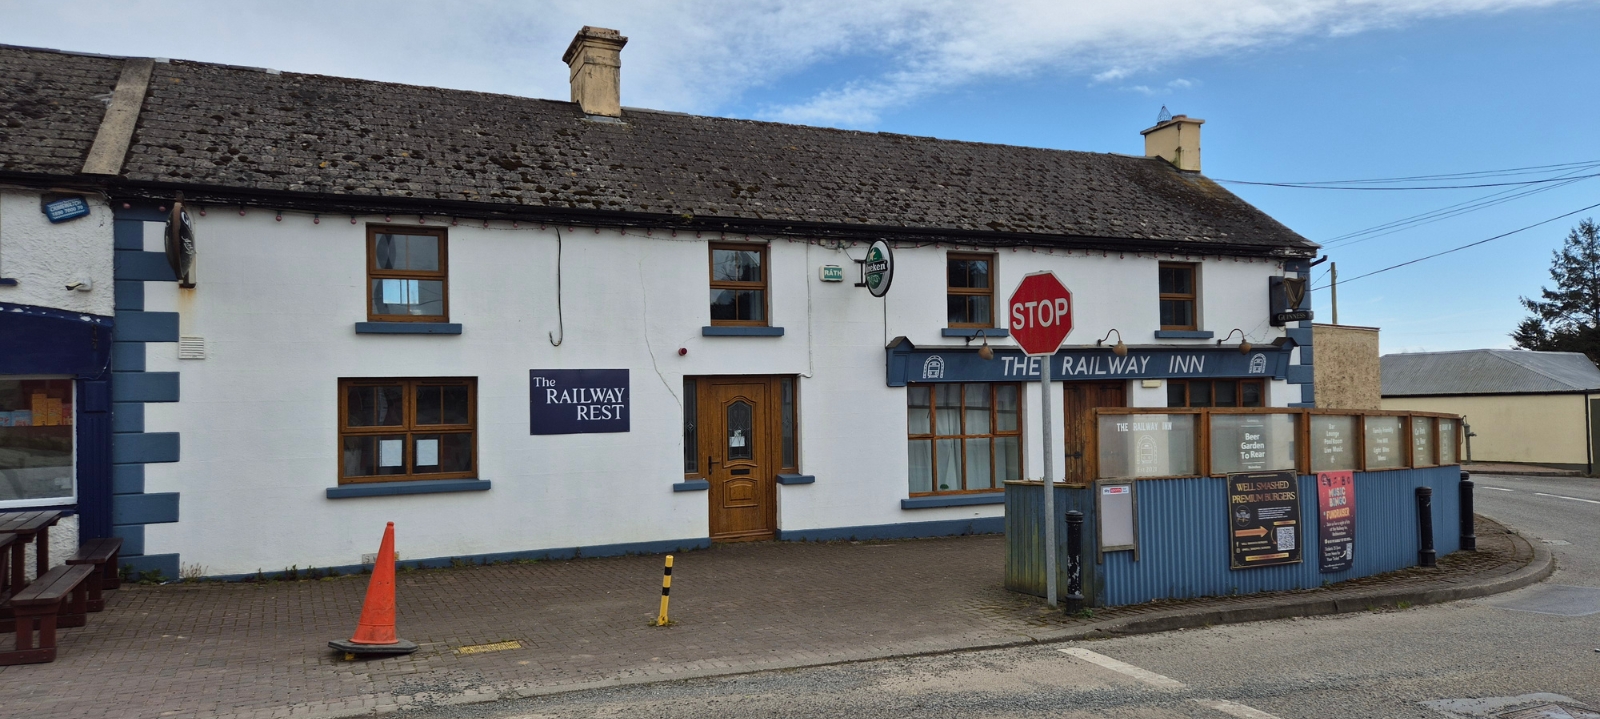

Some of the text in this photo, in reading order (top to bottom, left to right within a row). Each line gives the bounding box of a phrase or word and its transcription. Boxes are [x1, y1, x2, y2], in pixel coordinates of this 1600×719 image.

[1012, 297, 1069, 330] STOP
[1277, 312, 1307, 321] GUINNESS
[1001, 355, 1205, 376] THE RAILWAY INN
[533, 376, 556, 387] The
[546, 387, 625, 404] RAILWAY
[577, 404, 625, 421] REST
[1116, 422, 1129, 432] THE
[1132, 422, 1159, 431] RAILWAY
[1241, 442, 1264, 450] Garden
[1240, 452, 1250, 460] To
[1235, 480, 1290, 492] WELL SMASHED
[1231, 491, 1296, 504] PREMIUM BURGERS
[1329, 487, 1346, 498] MUSIC
[1329, 496, 1346, 507] BINGO
[1326, 507, 1350, 520] FUNDRAISER
